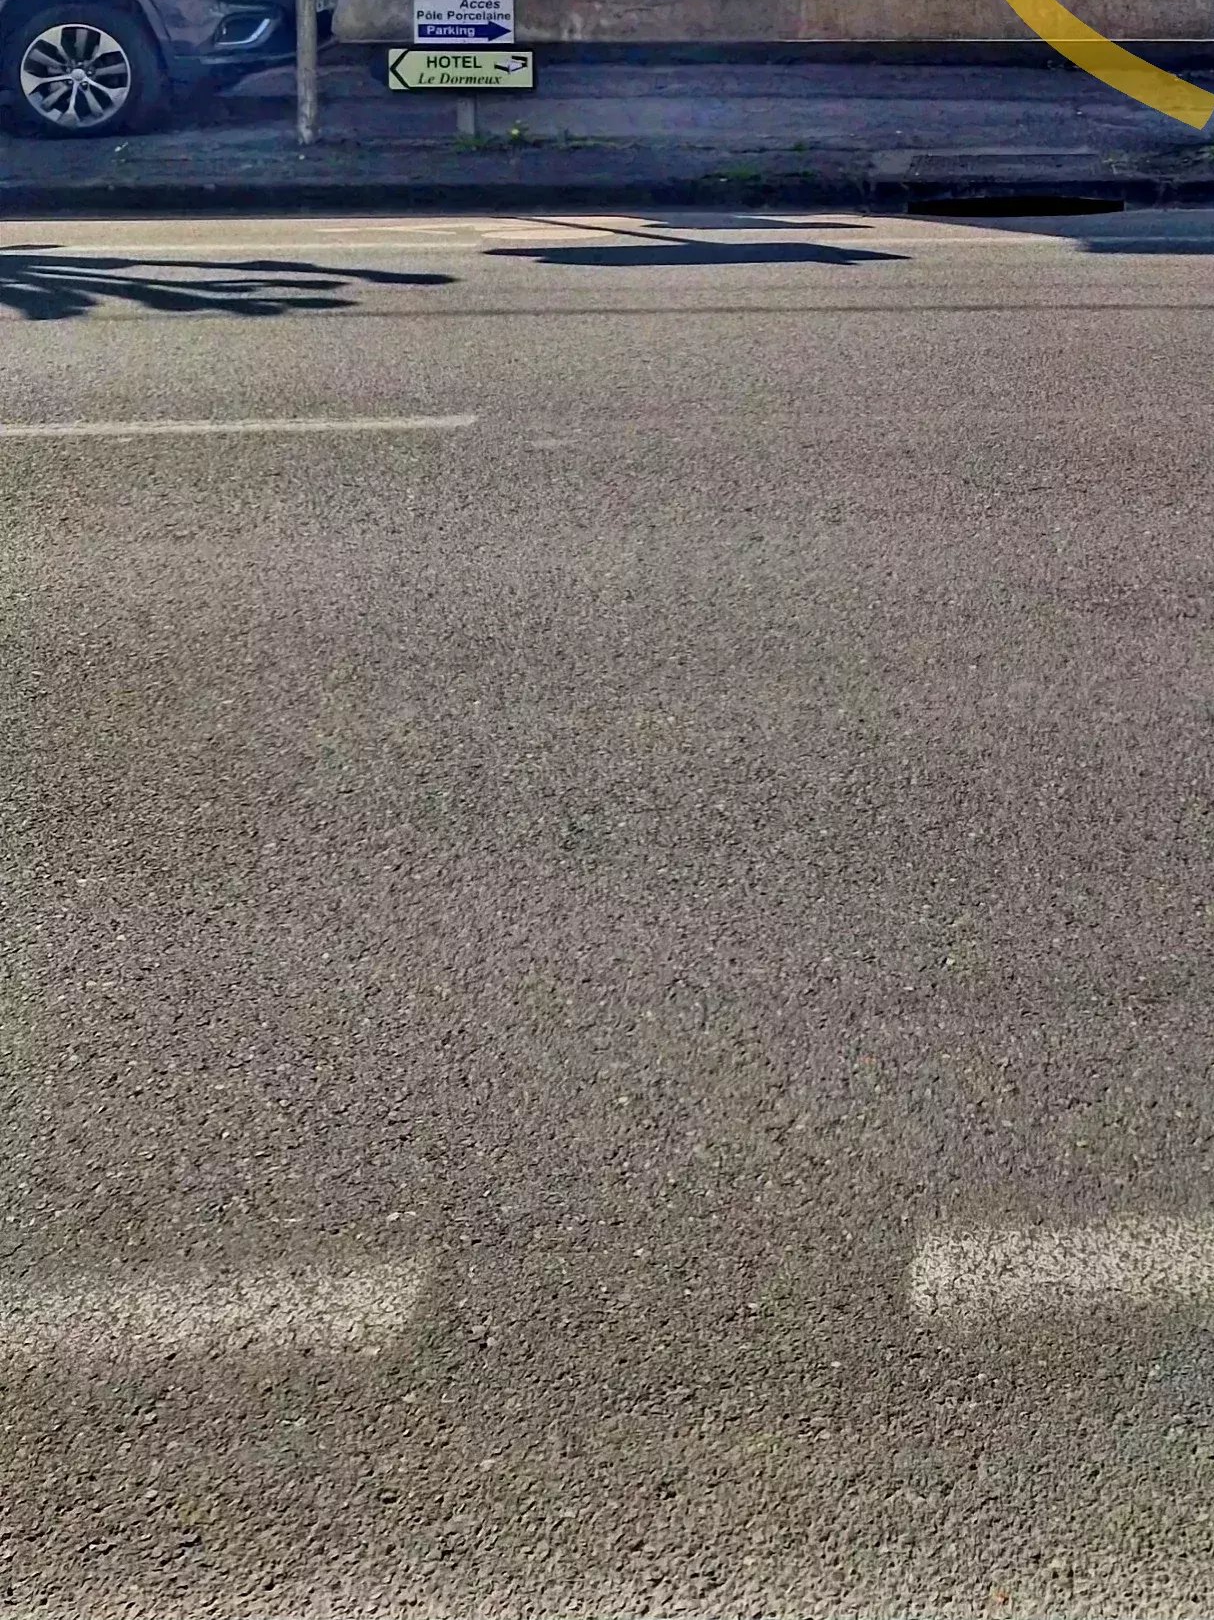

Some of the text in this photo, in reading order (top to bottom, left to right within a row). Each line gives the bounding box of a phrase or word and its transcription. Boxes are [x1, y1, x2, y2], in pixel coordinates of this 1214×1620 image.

[417, 10, 511, 21] Pôle Porcelaine
[426, 25, 475, 37] Parking
[427, 56, 482, 68] HOTEL
[418, 72, 502, 84] Le Dormeux
